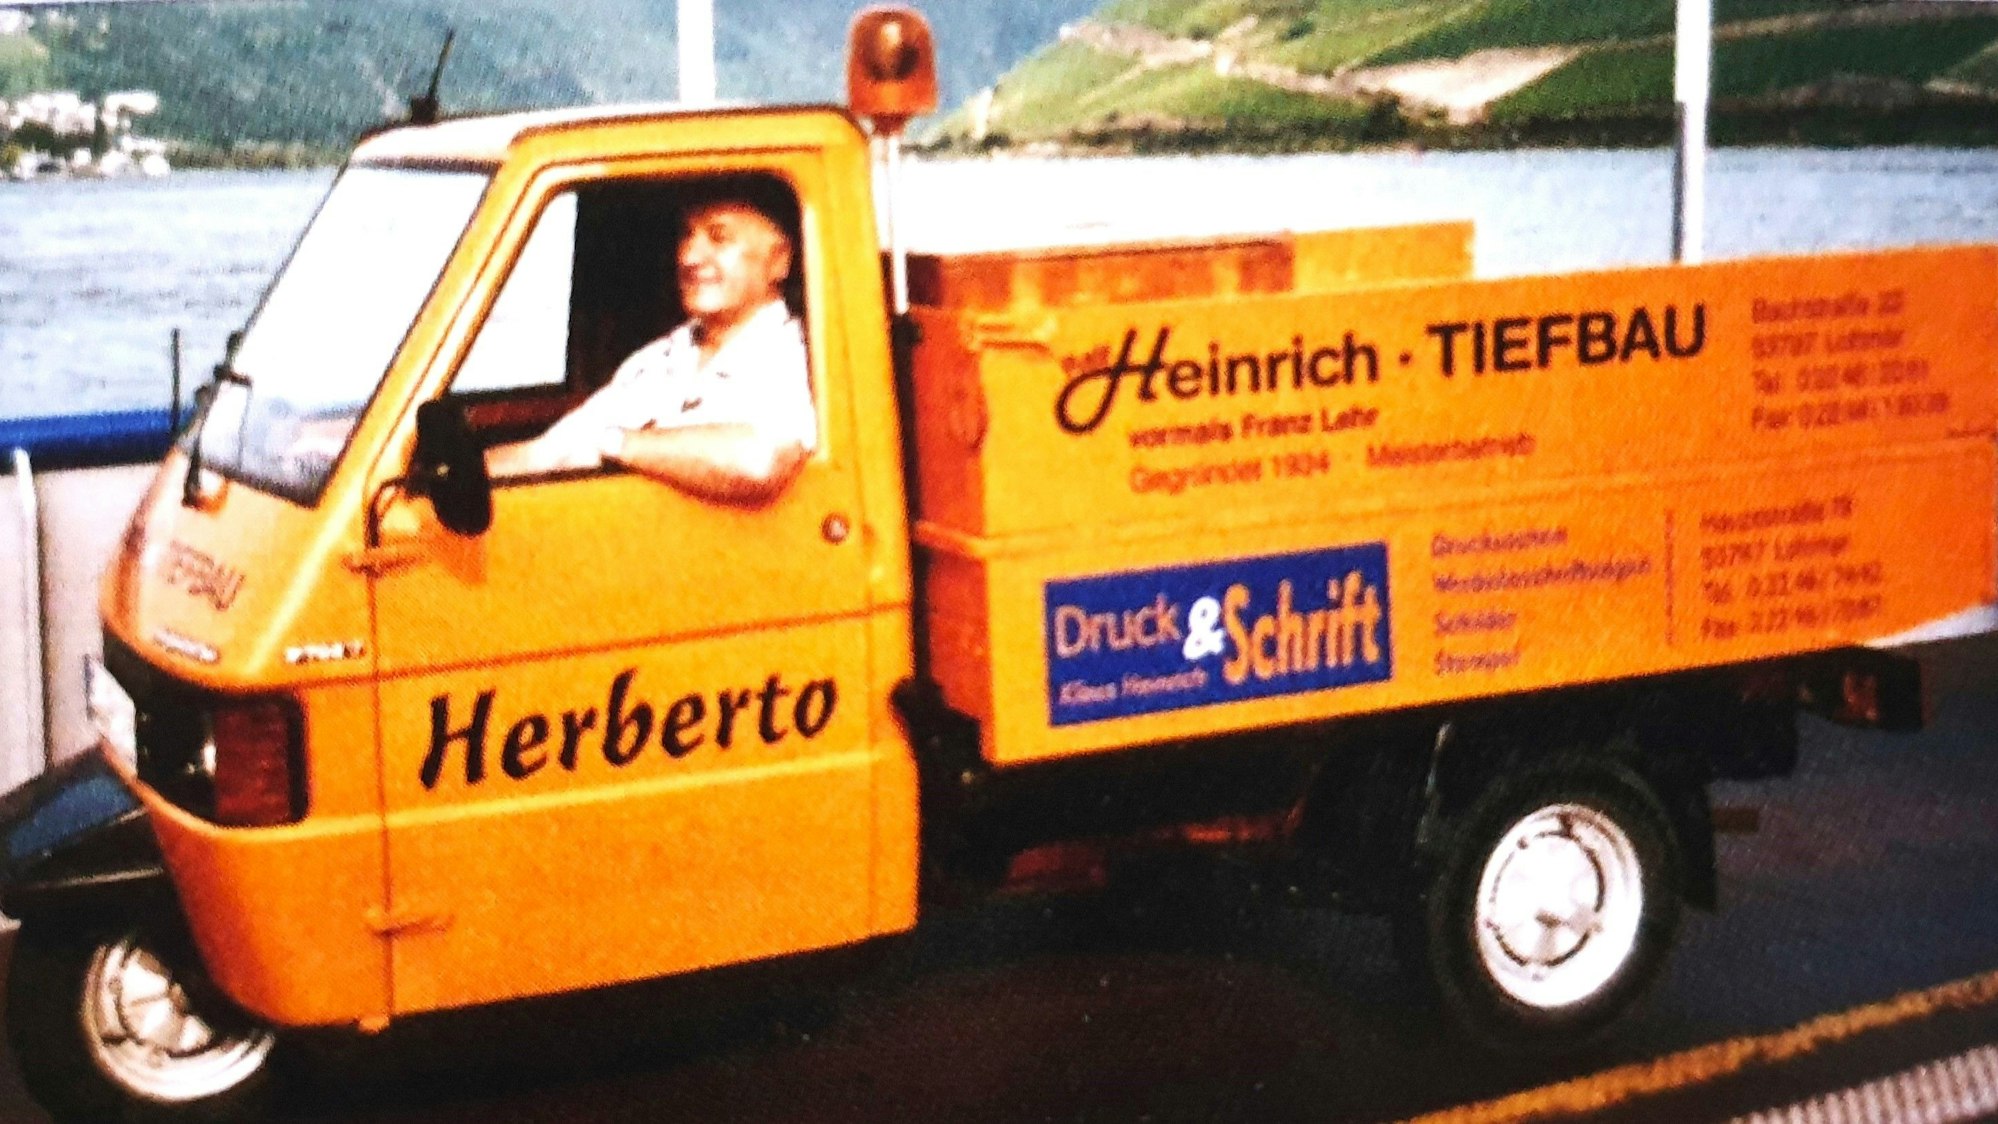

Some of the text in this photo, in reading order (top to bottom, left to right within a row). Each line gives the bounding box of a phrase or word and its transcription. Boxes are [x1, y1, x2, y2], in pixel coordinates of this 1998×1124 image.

[1055, 326, 1379, 434] Heinrich
[1426, 302, 1705, 378] TIEFBAU
[1128, 405, 1379, 448] vormals Franz Lehr
[1054, 569, 1383, 686] Druck & Schrift
[419, 668, 839, 791] Herberto
